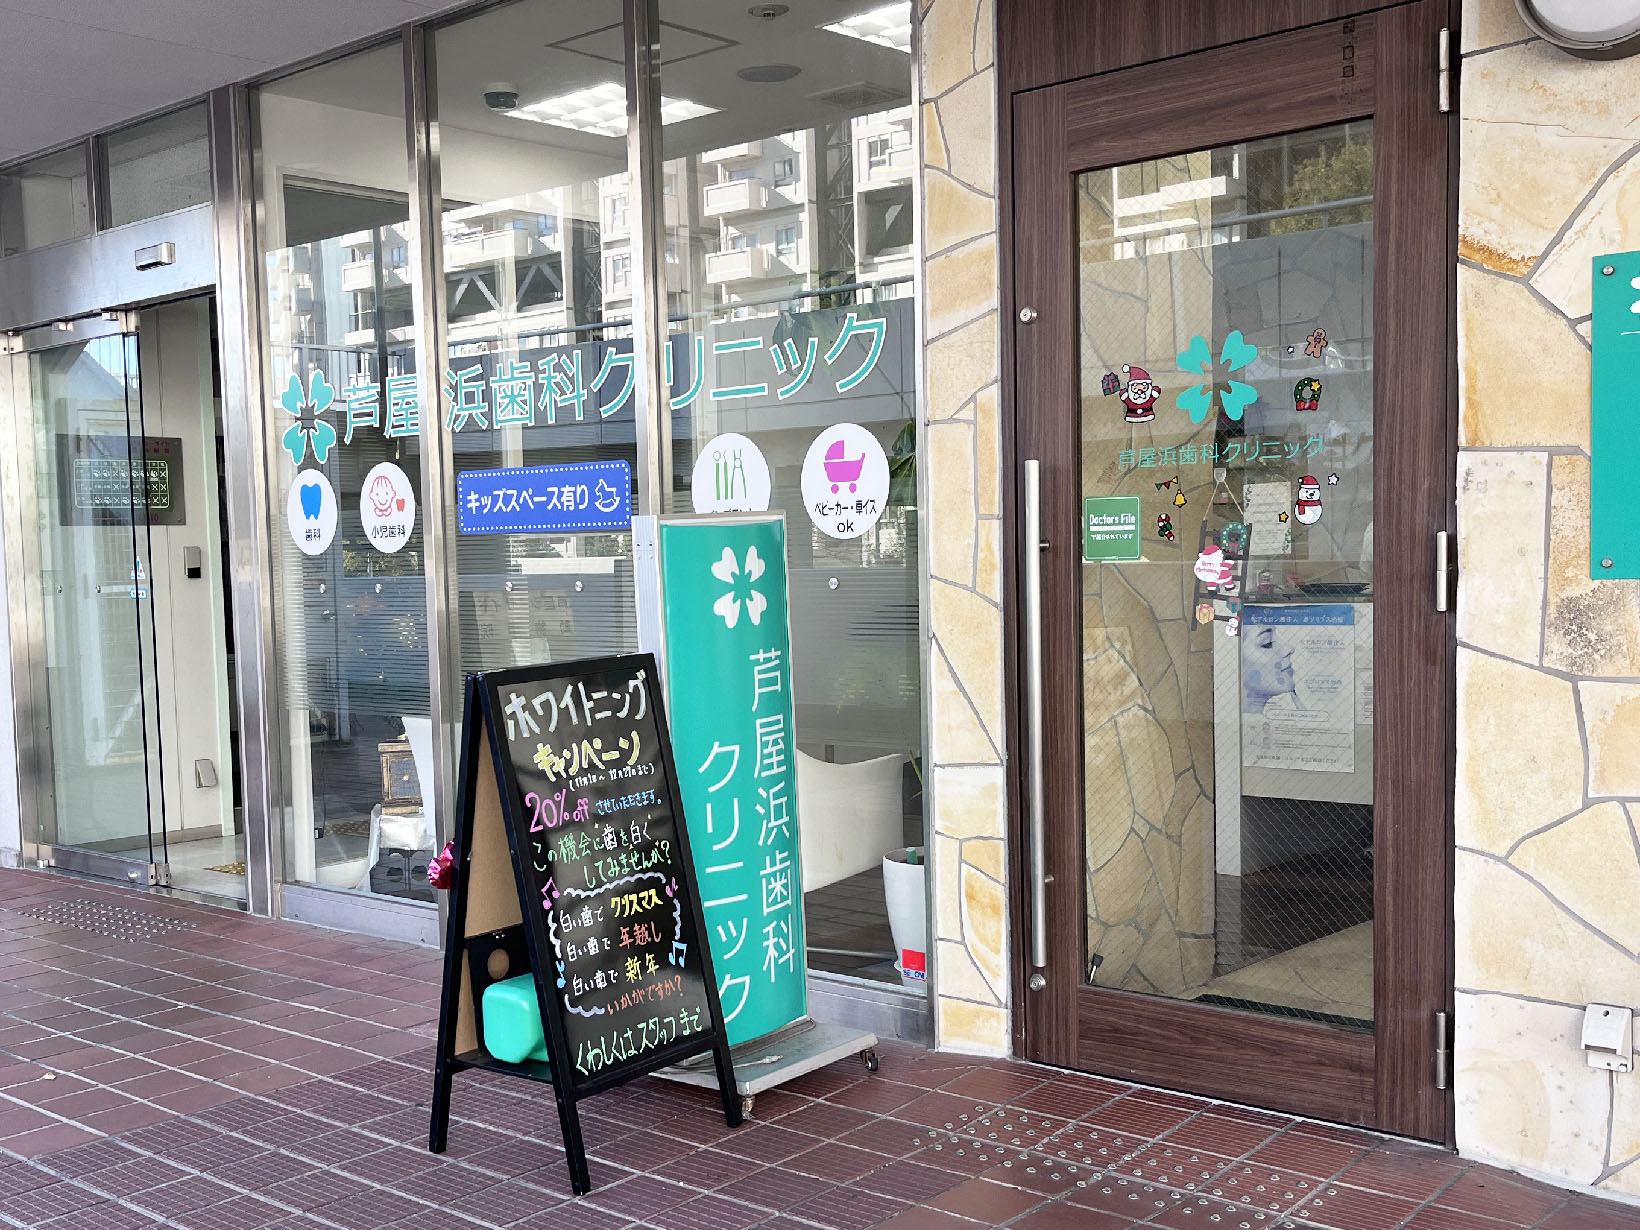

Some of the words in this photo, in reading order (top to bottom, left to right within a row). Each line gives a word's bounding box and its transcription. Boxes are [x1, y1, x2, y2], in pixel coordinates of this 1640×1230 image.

[1118, 436, 1324, 469] 芦屋浜歯科クリニック
[466, 484, 589, 515] キッズスペース有り
[815, 499, 877, 516] ベビーカー・車イス
[1089, 513, 1119, 525] Doctors
[1120, 512, 1136, 523] File
[305, 528, 321, 541] 歯科
[371, 524, 406, 539] 小児歯科
[504, 669, 647, 741] ホワイトニング
[533, 730, 641, 782] キャンペーン
[525, 789, 570, 832] 20%
[573, 798, 590, 823] off
[748, 647, 796, 983] 芦屋浜歯科
[532, 820, 652, 871] この機会に歯を白く
[698, 740, 751, 1024] クリニック
[559, 905, 604, 932] 白い歯で
[610, 888, 664, 918] クリスマス
[566, 937, 611, 961] 白い歯で
[619, 921, 662, 949] 年越し
[573, 969, 619, 996] 白い歯で
[625, 952, 660, 984] 新年
[575, 1006, 704, 1076] くわしくはスタッフまで
